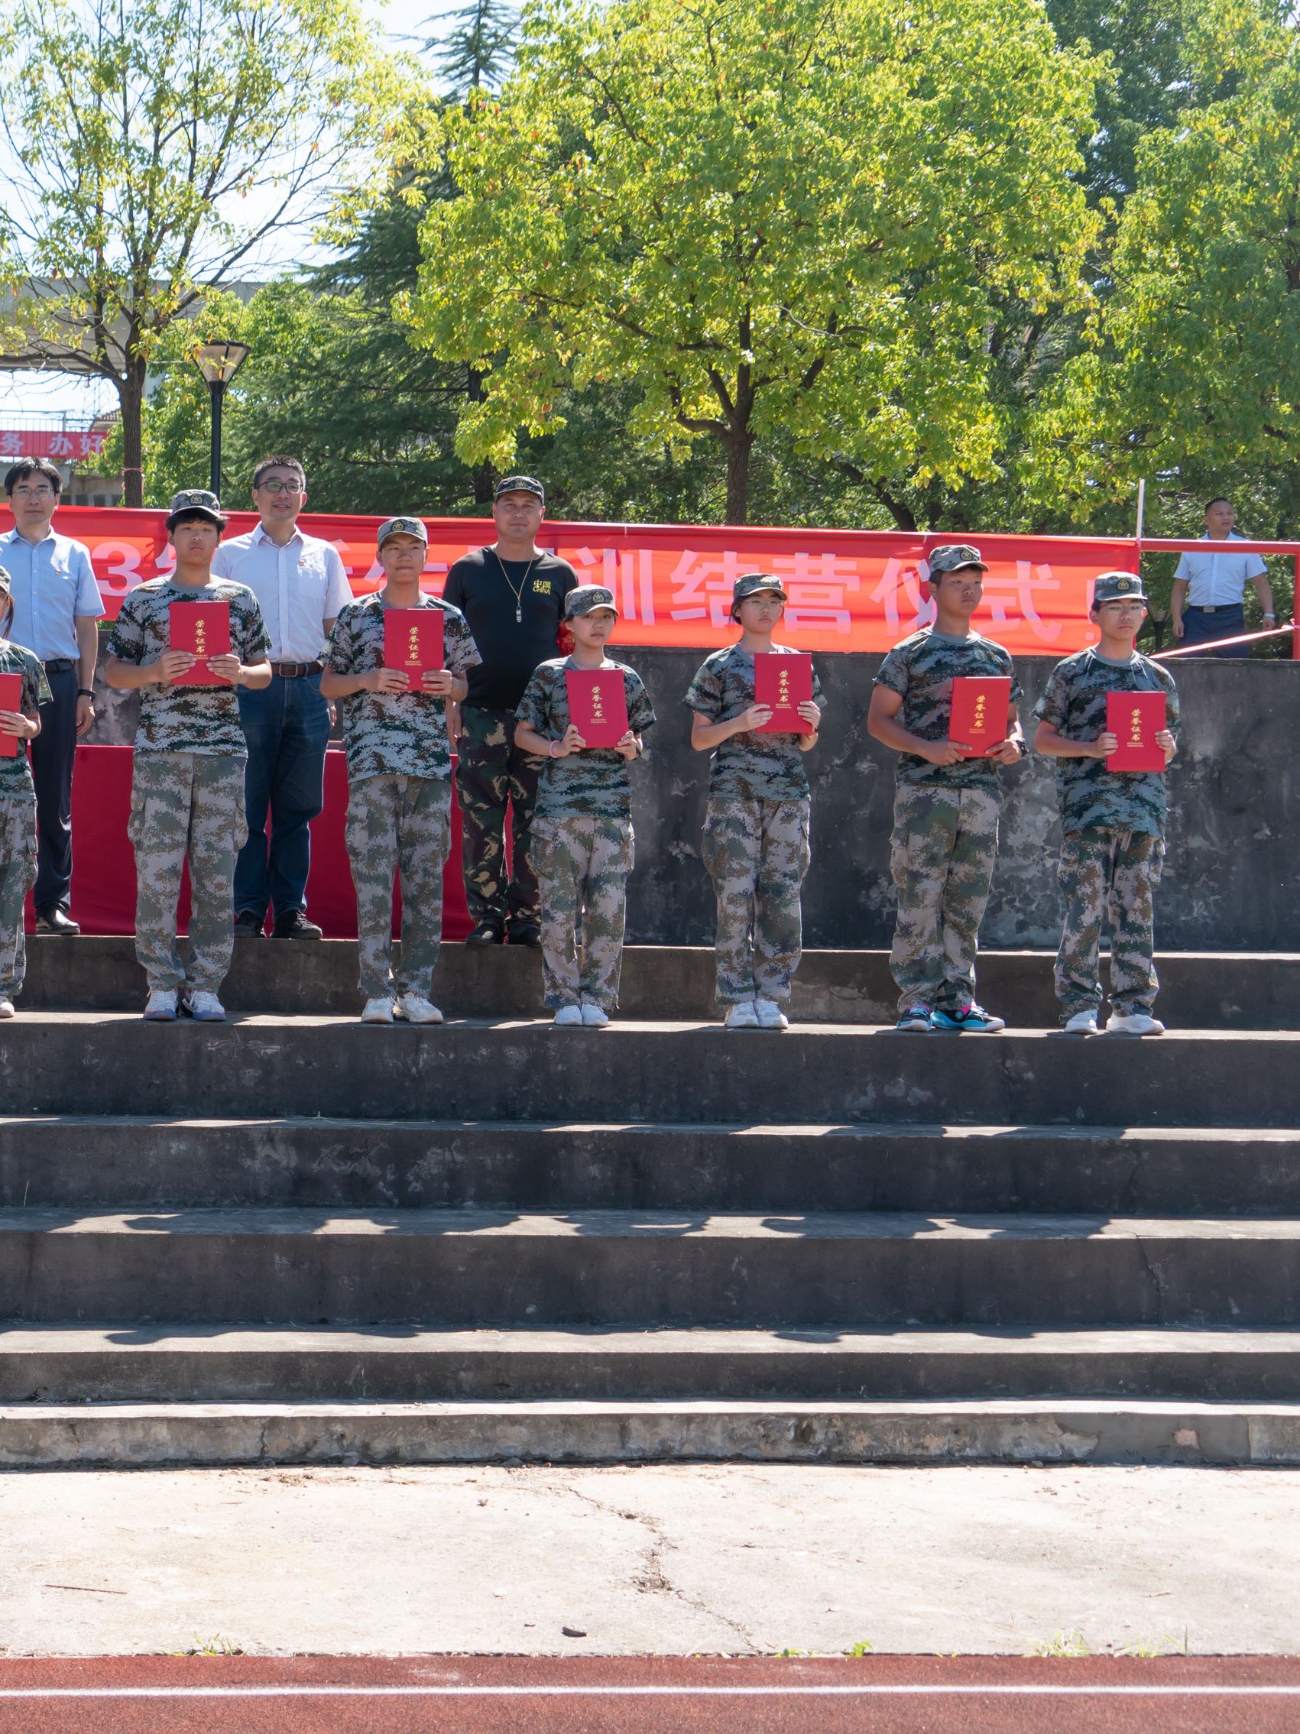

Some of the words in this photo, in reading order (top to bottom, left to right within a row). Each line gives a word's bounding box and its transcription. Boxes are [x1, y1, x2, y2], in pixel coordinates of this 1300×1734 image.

[49, 433, 104, 456] 办好
[194, 620, 207, 653] 荣誉证书
[408, 626, 420, 659] 荣誉证书
[591, 686, 603, 717] 荣誉证书
[778, 670, 791, 703] 荣誉证书
[973, 695, 986, 727] 荣誉证书
[1130, 709, 1143, 741] 荣誉证书
